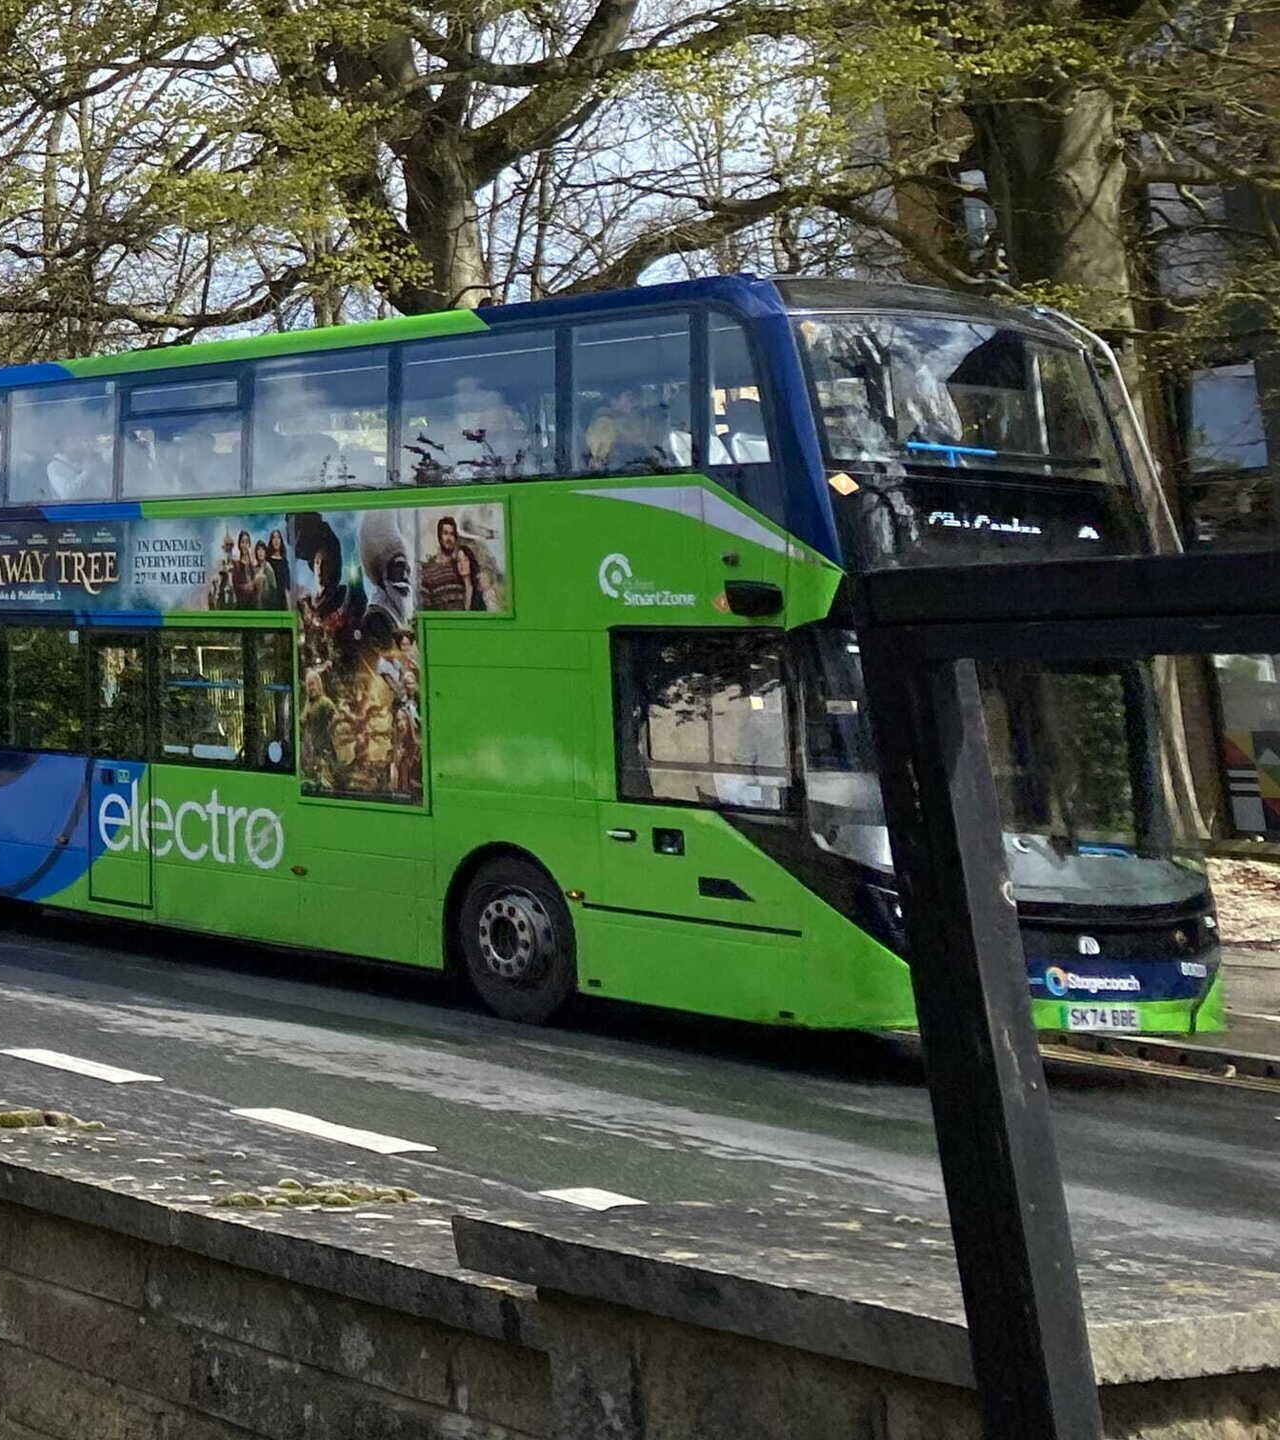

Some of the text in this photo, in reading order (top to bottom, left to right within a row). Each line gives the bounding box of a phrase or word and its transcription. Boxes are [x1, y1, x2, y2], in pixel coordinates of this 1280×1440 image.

[137, 539, 202, 552] IN CINEMAS
[134, 554, 206, 569] EVERYWHERE
[55, 549, 121, 595] TREE
[160, 570, 206, 585] MARCH
[623, 590, 697, 607] SmartZone
[98, 778, 285, 870] electro
[1068, 972, 1141, 994] Stagecoach
[1070, 1009, 1108, 1027] SK74
